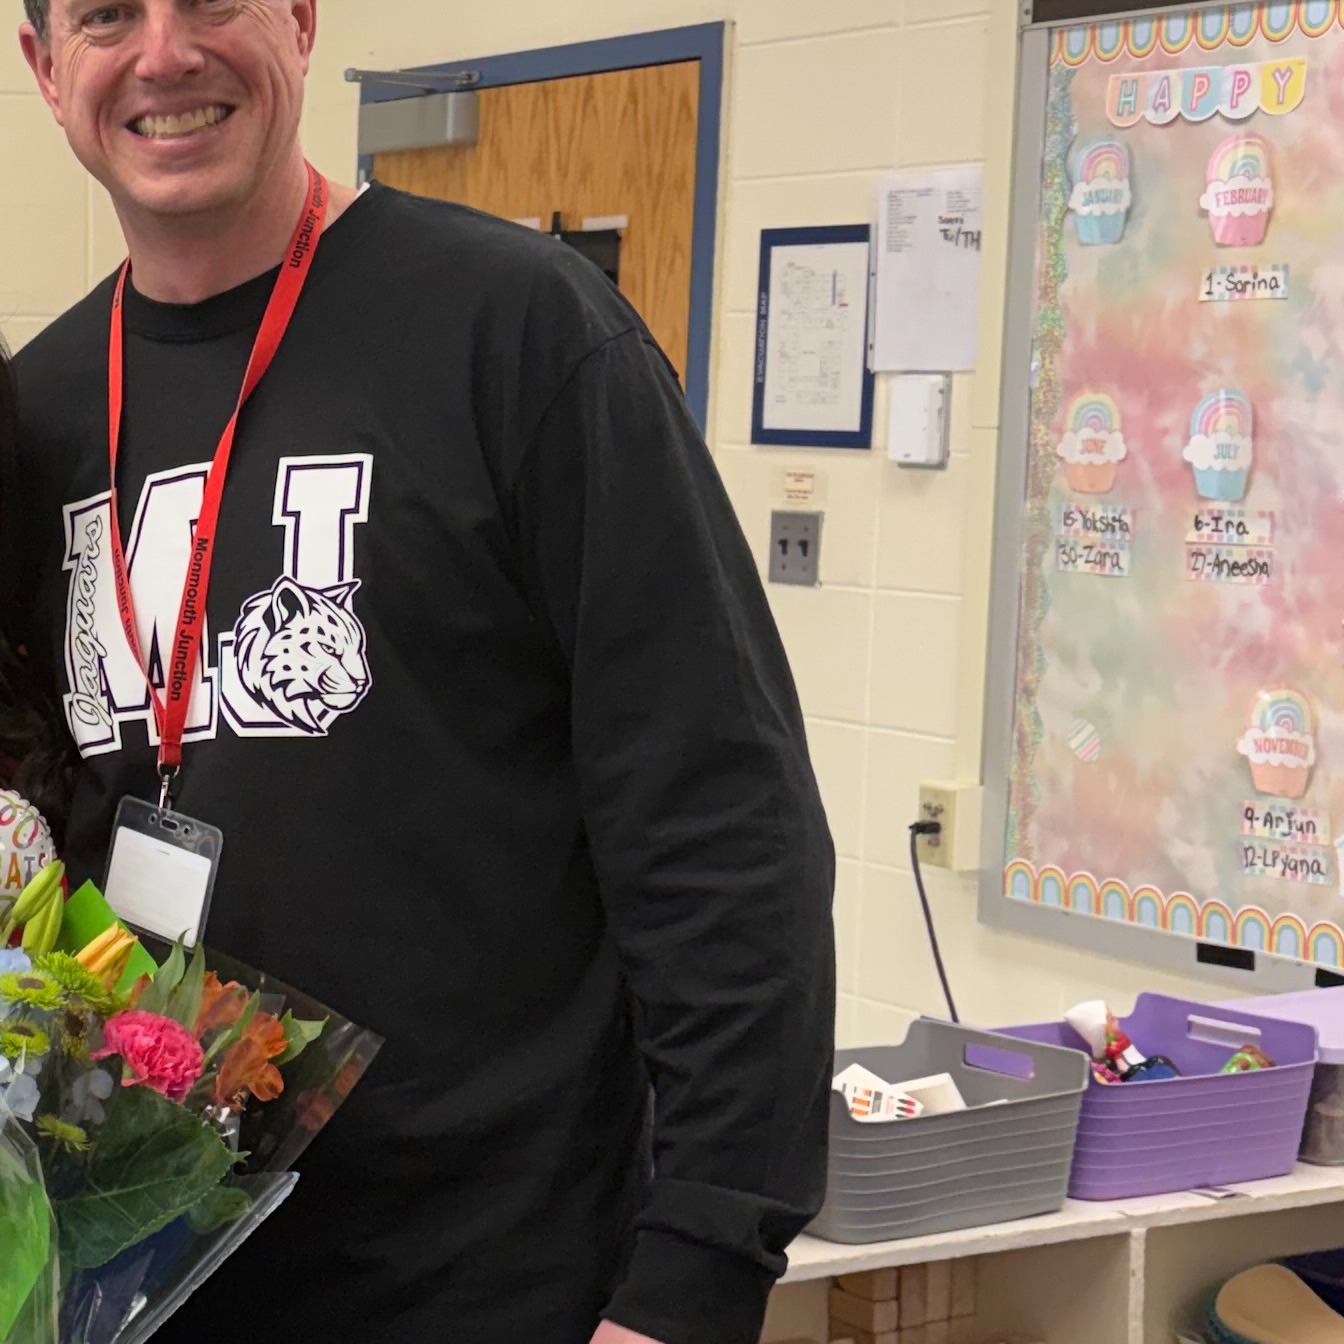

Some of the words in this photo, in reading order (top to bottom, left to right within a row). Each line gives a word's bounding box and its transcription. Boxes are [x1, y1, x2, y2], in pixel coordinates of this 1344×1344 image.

[1115, 66, 1294, 117] HAPPY
[1082, 187, 1124, 207] JANUARY
[1215, 187, 1270, 206] FEBRUARY
[289, 209, 321, 269] Junction
[1080, 438, 1106, 455] JUNE
[1214, 443, 1240, 460] JULY
[181, 537, 209, 624] Monmouth
[72, 514, 114, 728] Jaguars
[170, 629, 194, 702] Junction
[1253, 737, 1308, 761] NOVEMBER
